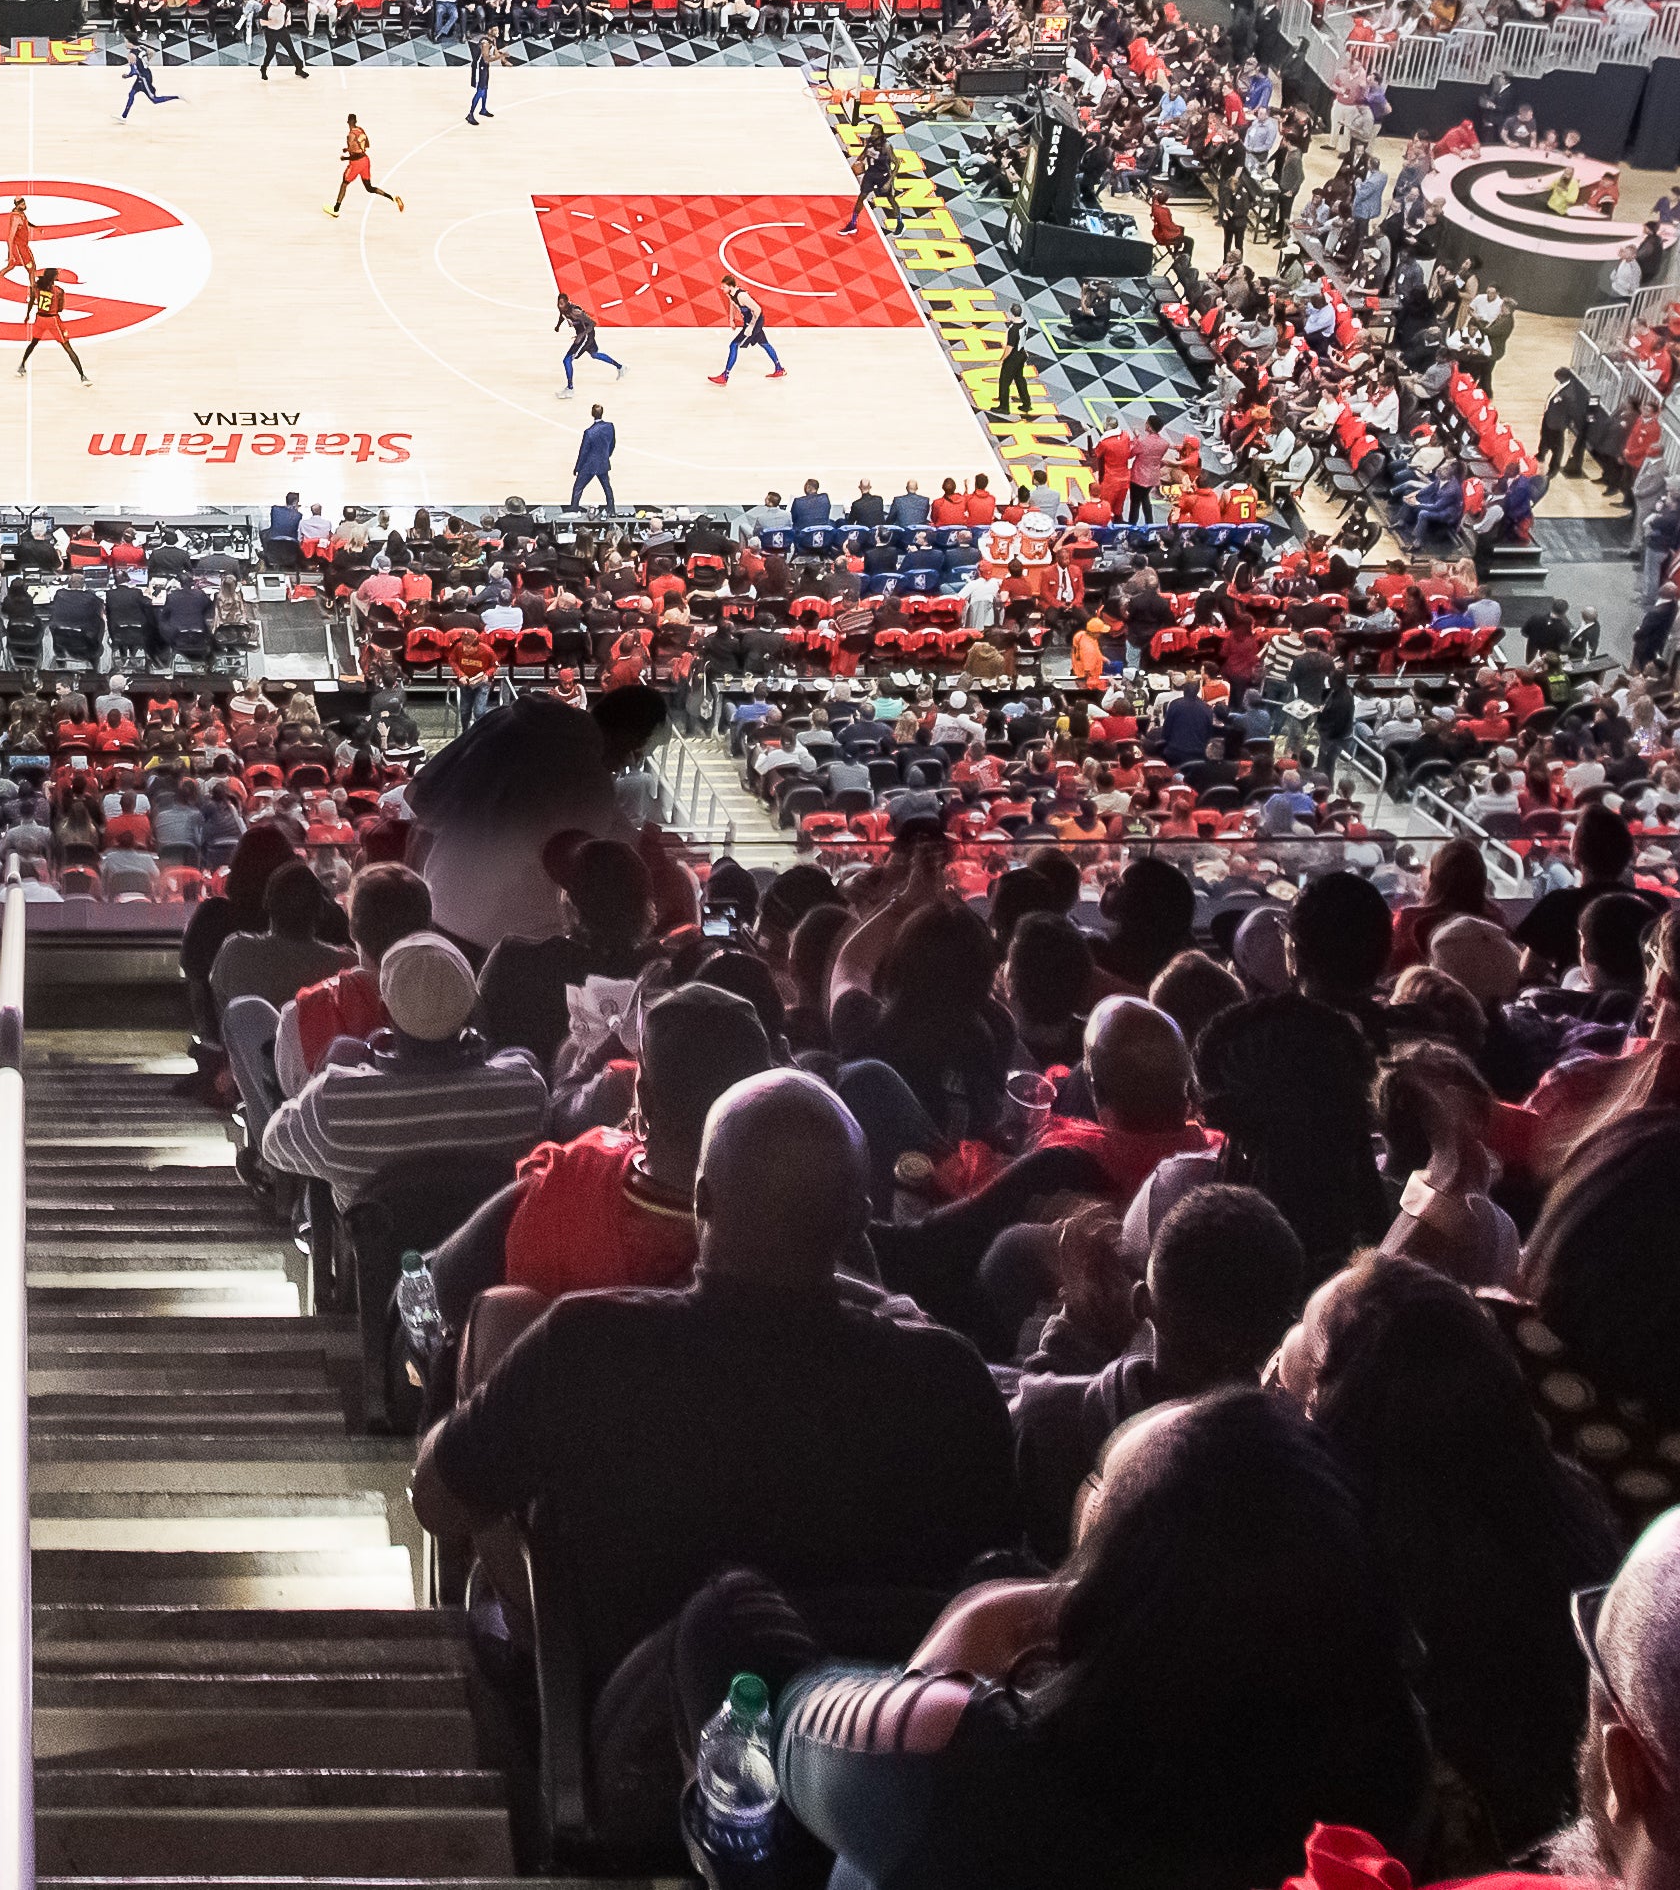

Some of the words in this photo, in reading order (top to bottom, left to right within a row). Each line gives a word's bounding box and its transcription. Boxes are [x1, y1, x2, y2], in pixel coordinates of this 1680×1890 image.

[1049, 125, 1063, 154] NBA
[1046, 156, 1058, 176] TV
[37, 298, 51, 313] 12
[193, 412, 301, 426] ARENA
[1240, 503, 1249, 519] 6
